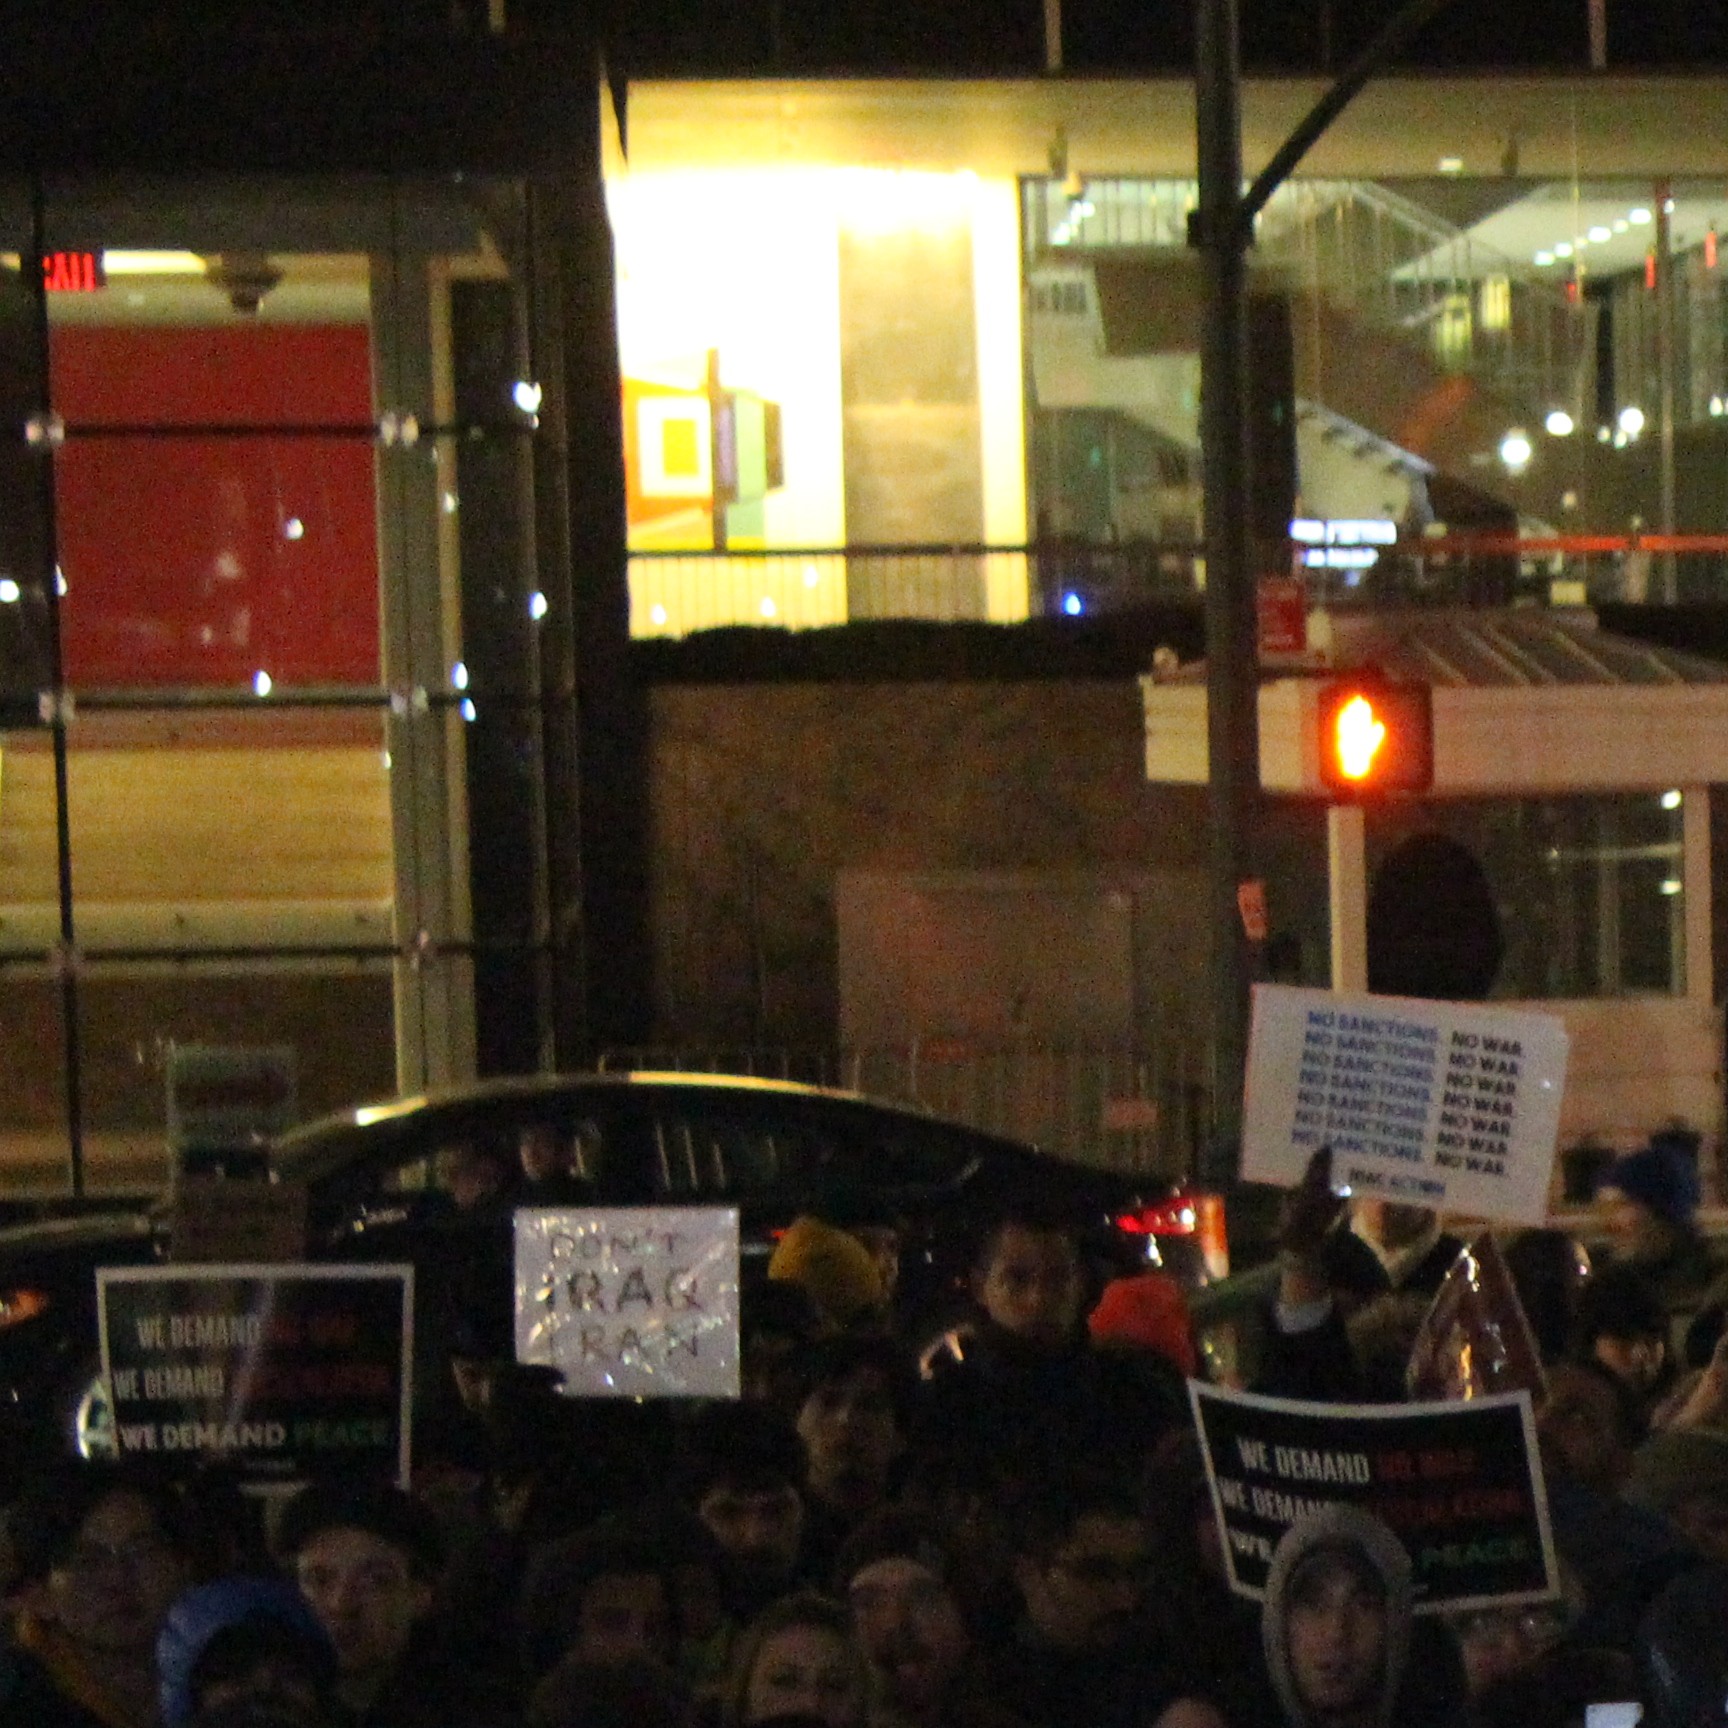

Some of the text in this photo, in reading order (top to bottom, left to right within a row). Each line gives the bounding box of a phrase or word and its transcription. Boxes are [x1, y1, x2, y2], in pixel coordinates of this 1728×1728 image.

[161, 1420, 288, 1451] DEMAND
[1236, 1434, 1273, 1473] WE
[1273, 1444, 1371, 1485] DEMAND
[1250, 1485, 1328, 1522] DEMA
